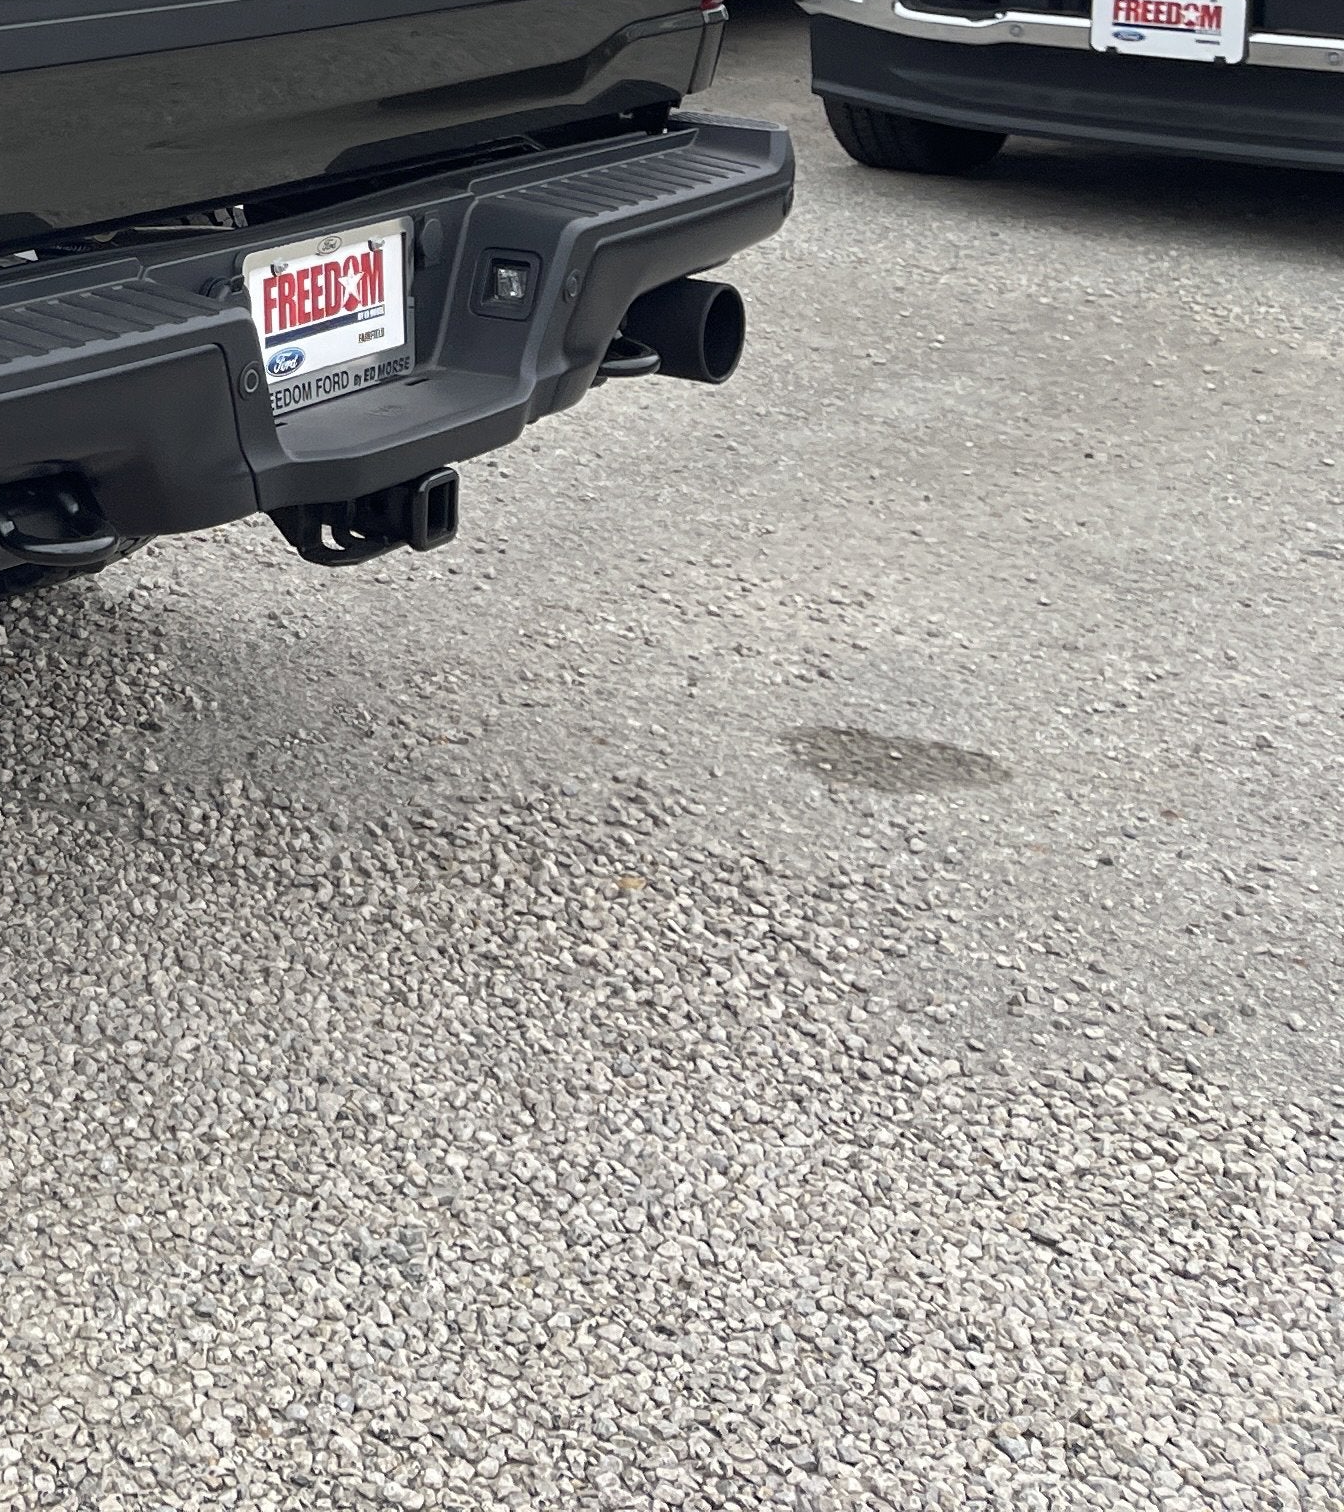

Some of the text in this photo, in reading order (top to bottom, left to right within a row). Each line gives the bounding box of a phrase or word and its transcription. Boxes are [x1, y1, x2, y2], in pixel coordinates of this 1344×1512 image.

[263, 249, 384, 334] FREEDOM
[273, 352, 299, 375] Ford
[316, 370, 350, 397] FORD
[364, 364, 377, 383] ED
[377, 355, 411, 380] MORSE
